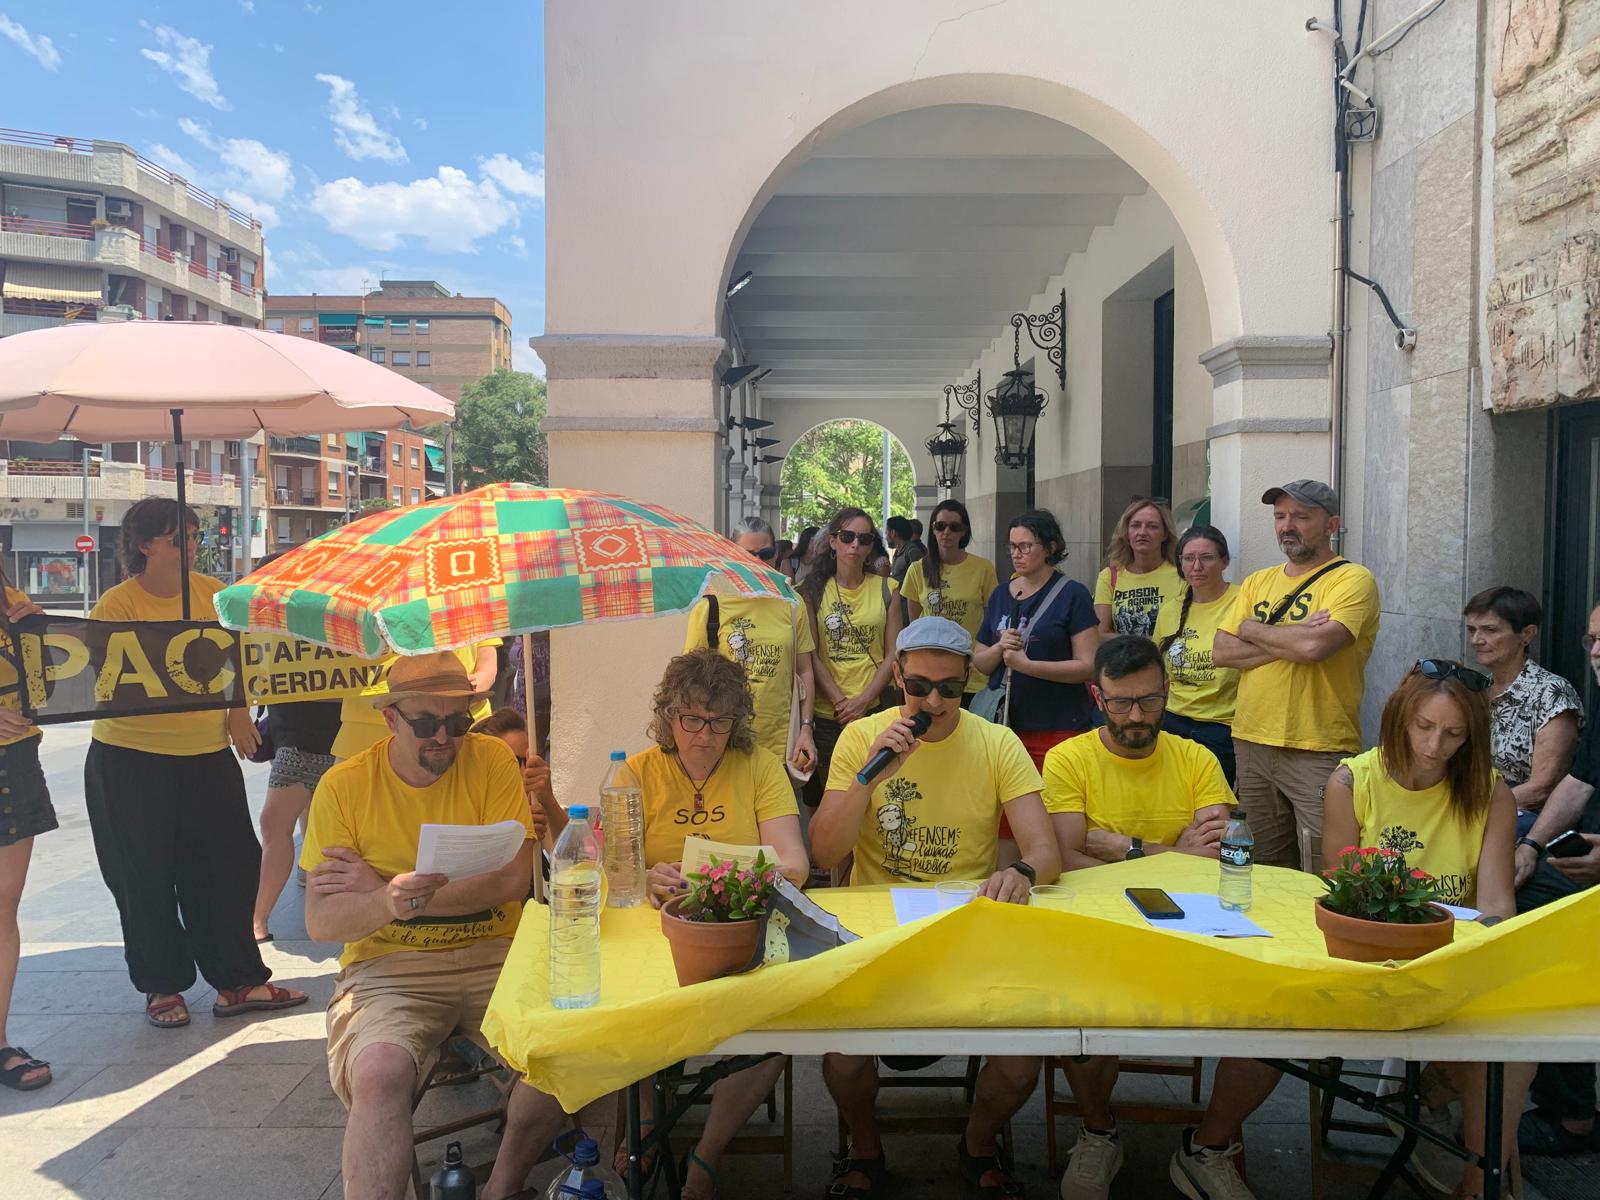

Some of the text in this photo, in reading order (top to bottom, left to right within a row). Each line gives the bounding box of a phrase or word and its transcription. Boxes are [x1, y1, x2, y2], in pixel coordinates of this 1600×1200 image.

[1114, 586, 1160, 601] REASON
[1127, 595, 1165, 607] AGAINST
[20, 628, 236, 710] PAC
[248, 664, 392, 697] CERDANY
[673, 804, 726, 826] SOS
[1220, 848, 1251, 860] BEZOYA
